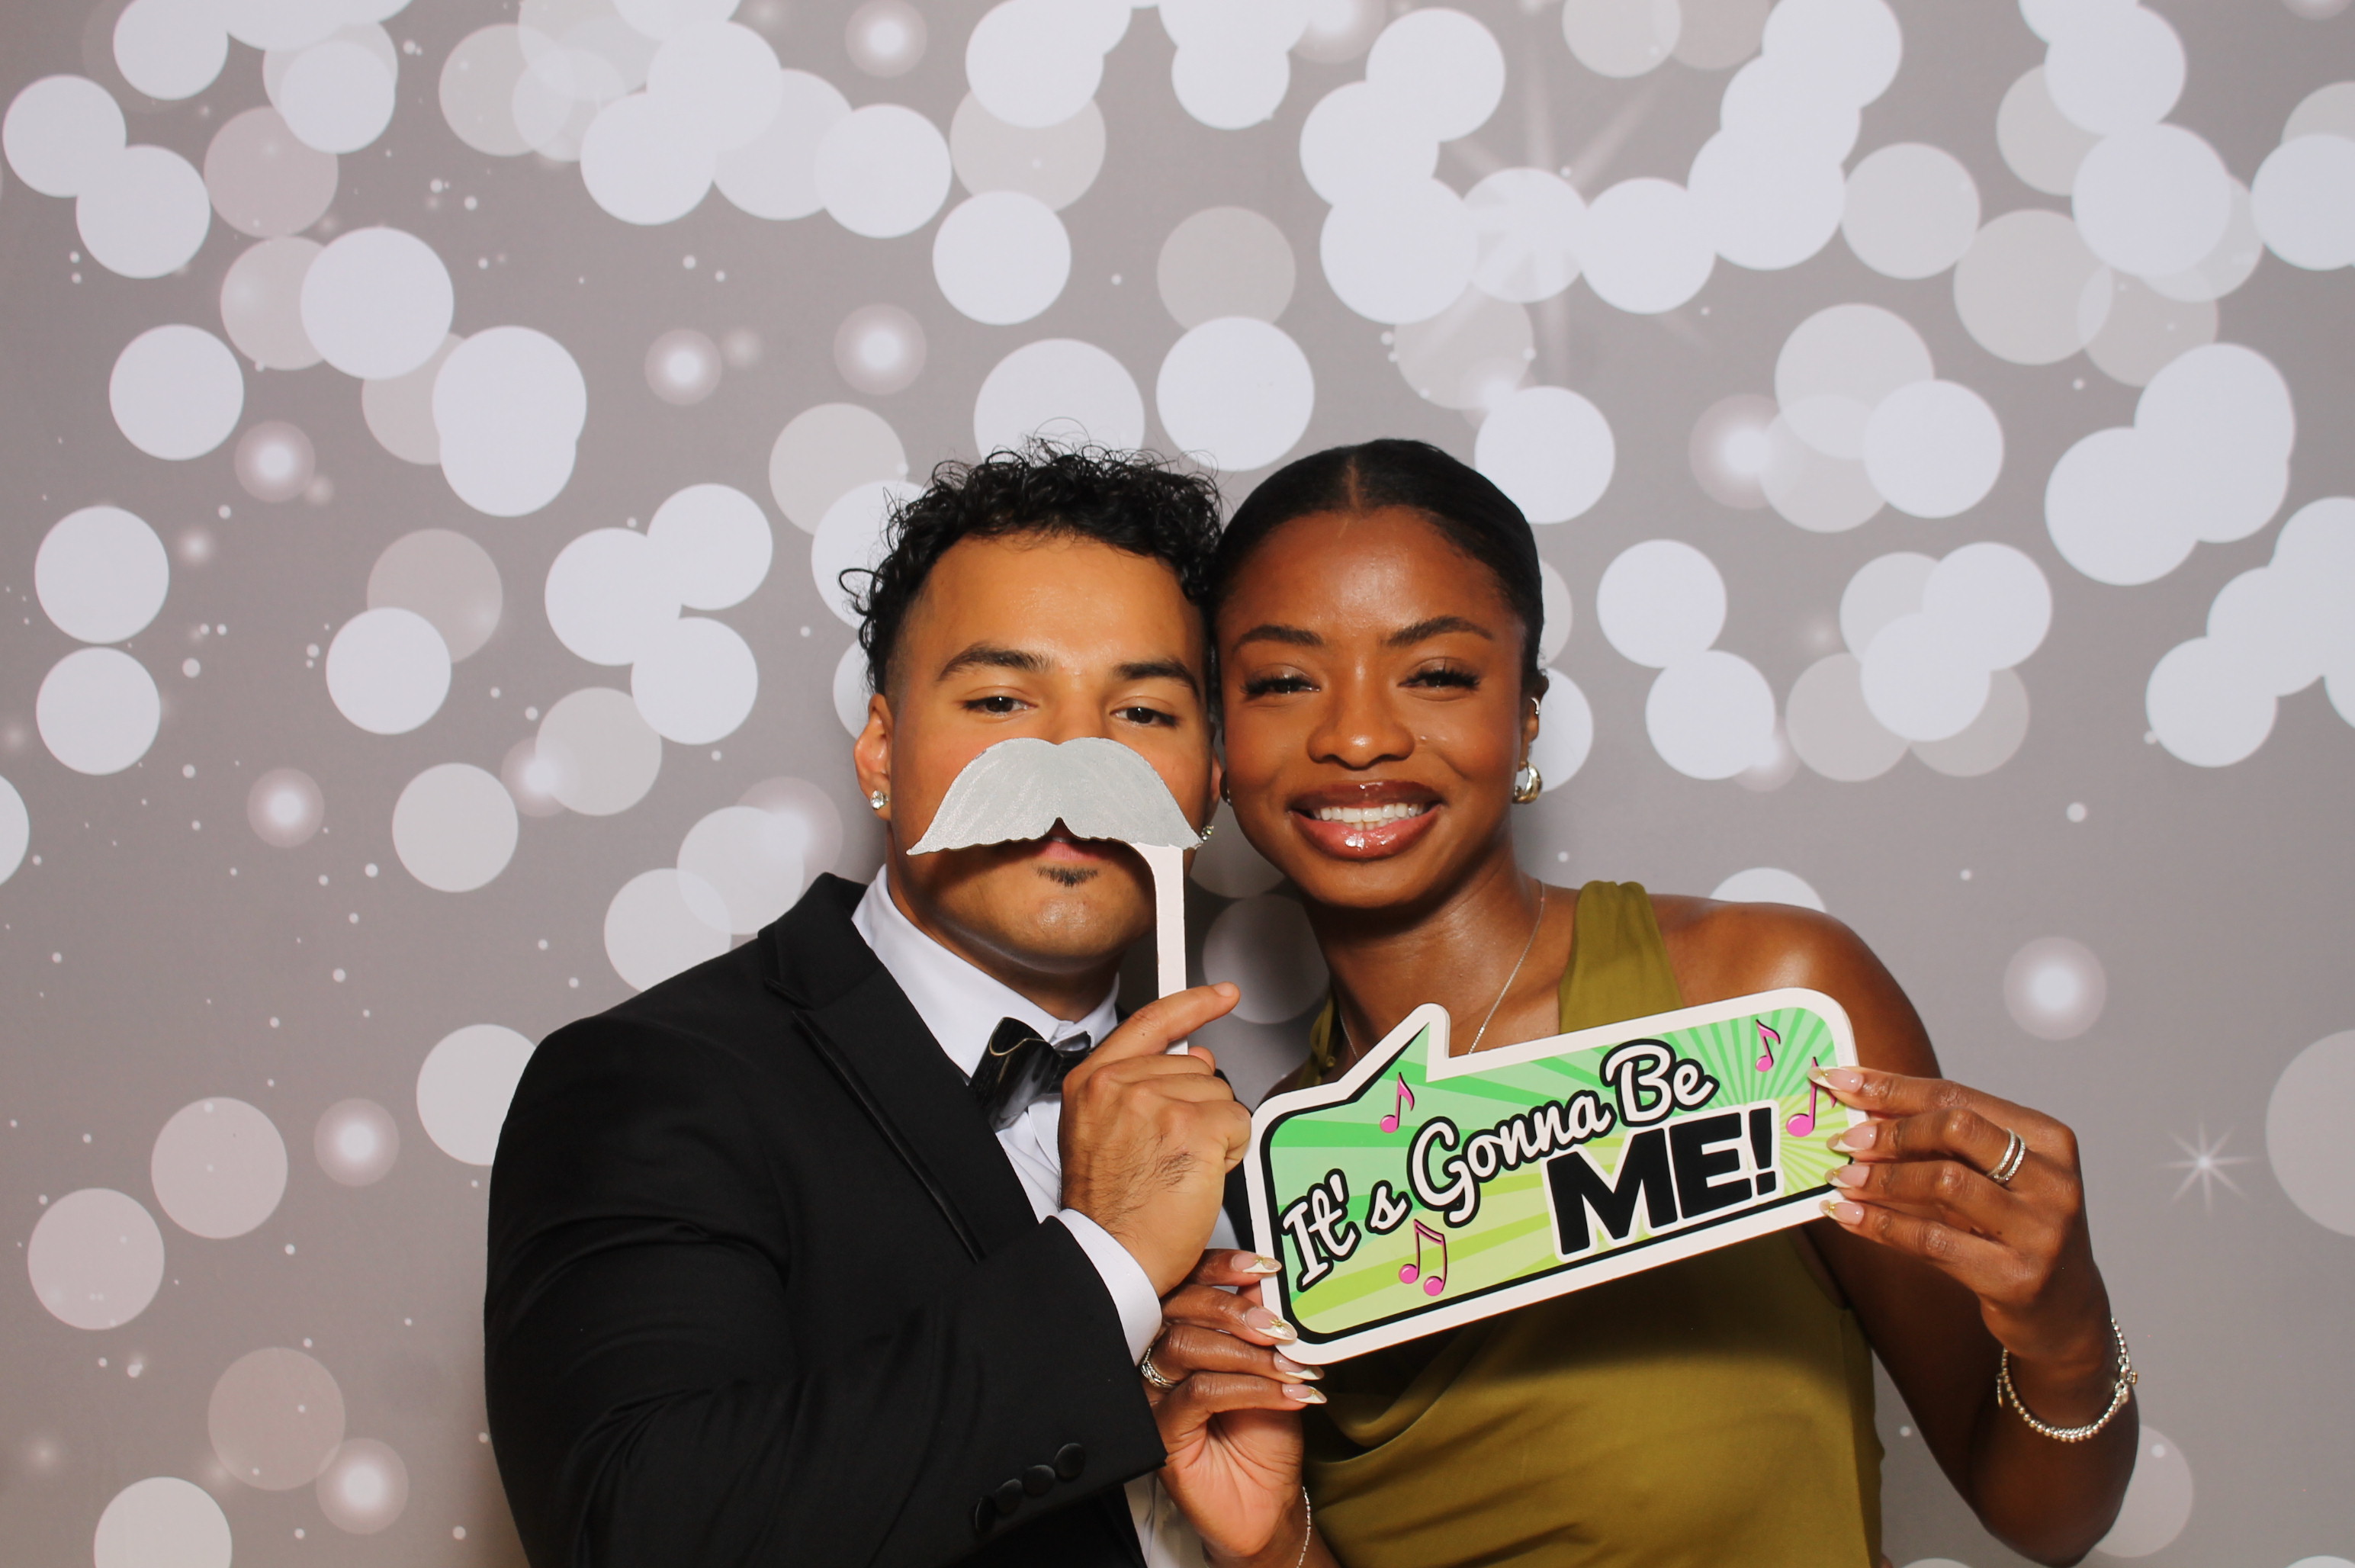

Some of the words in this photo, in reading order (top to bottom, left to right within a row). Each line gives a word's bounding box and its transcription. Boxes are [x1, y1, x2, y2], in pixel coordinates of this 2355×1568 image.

[1281, 1171, 1410, 1290] It's
[1408, 1091, 1613, 1225] Gonna
[1602, 1040, 1716, 1126] Be
[1547, 1106, 1779, 1257] ME!
